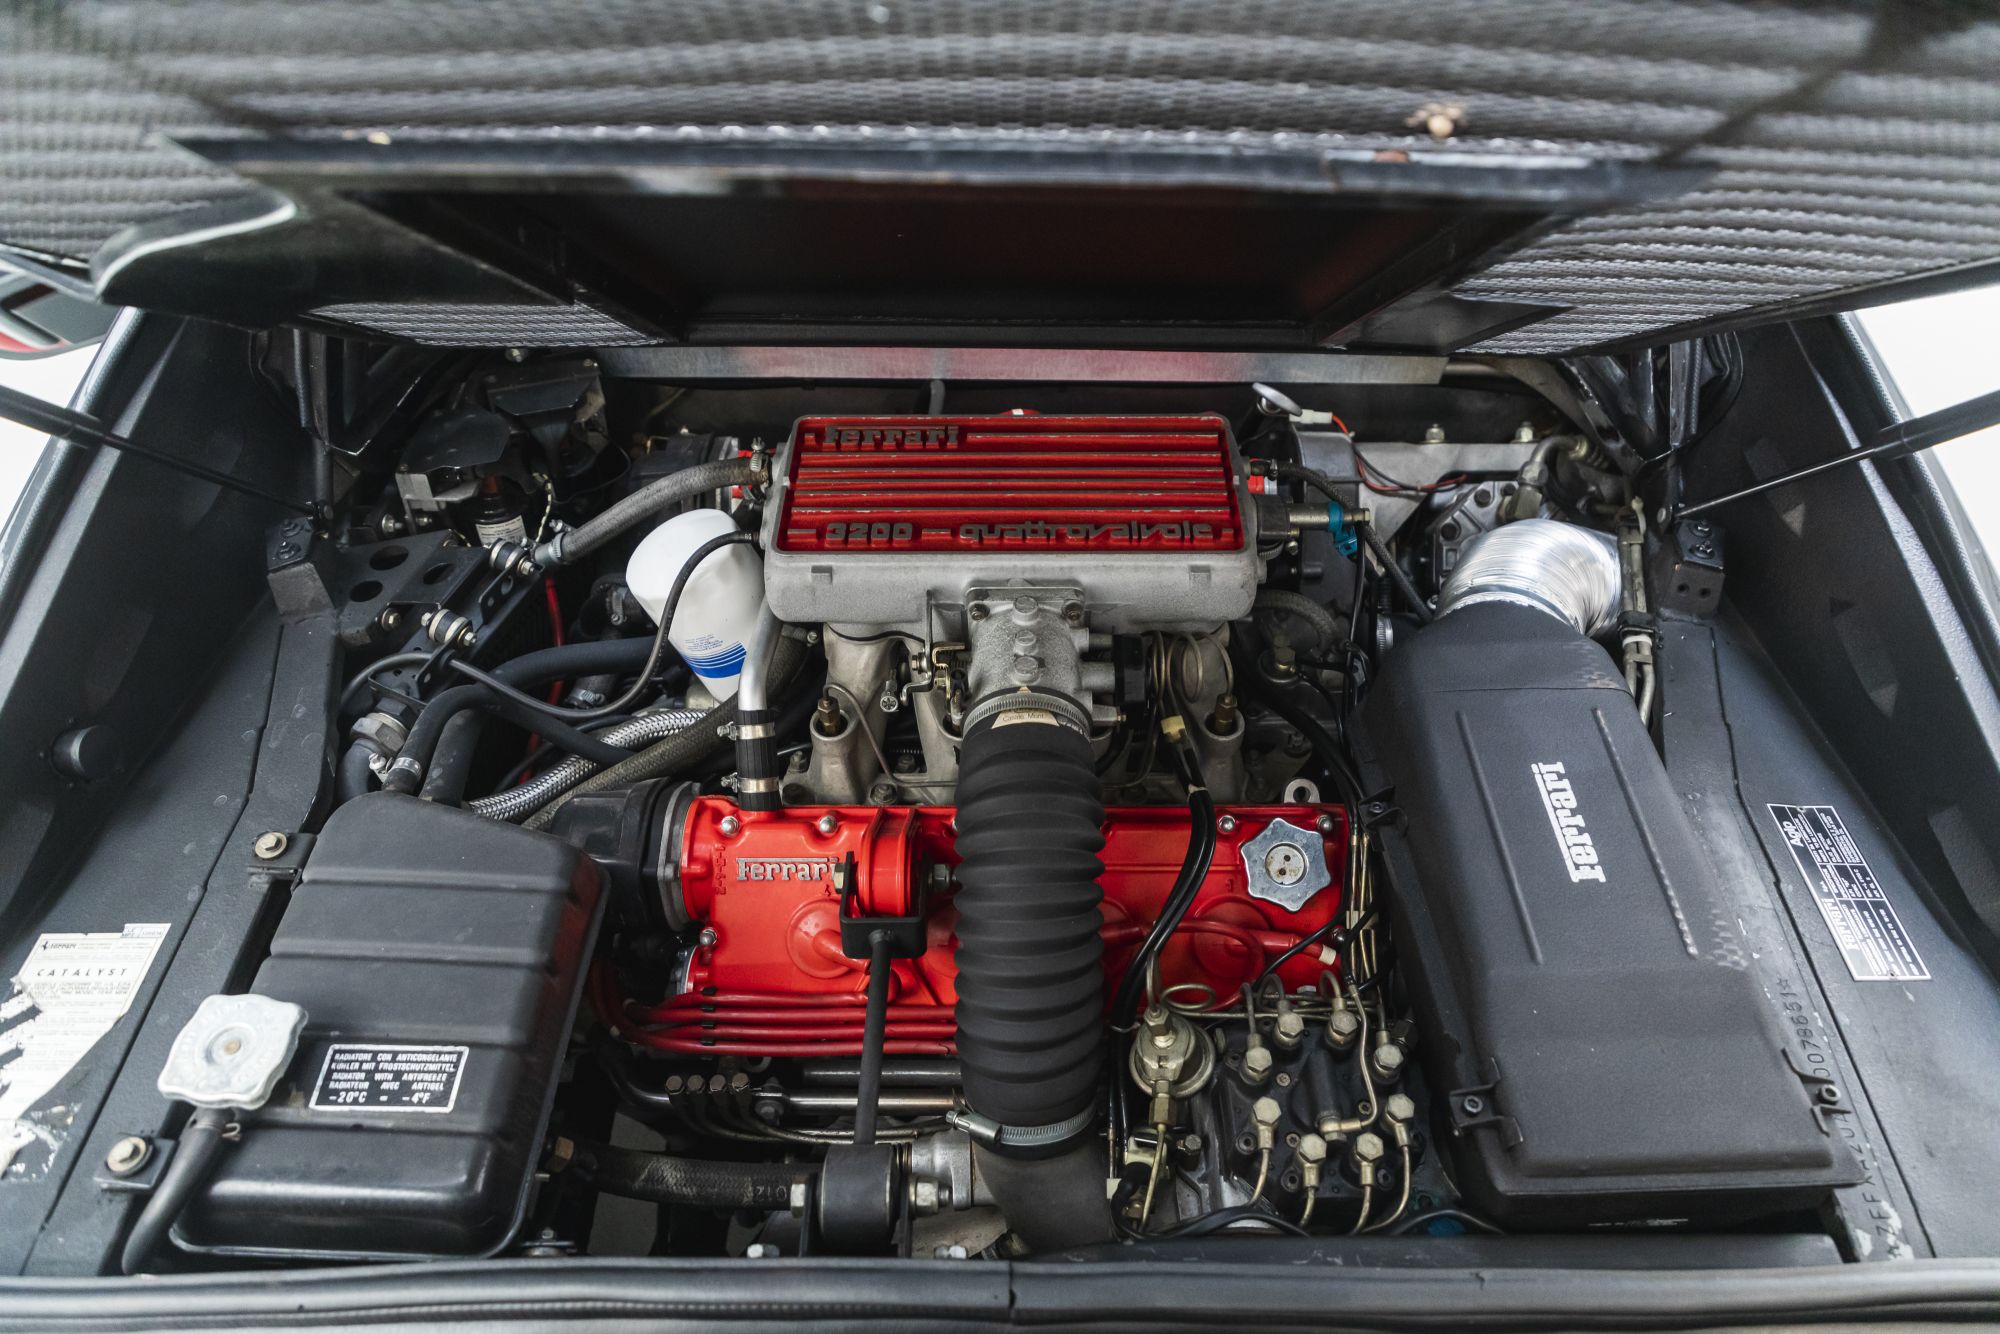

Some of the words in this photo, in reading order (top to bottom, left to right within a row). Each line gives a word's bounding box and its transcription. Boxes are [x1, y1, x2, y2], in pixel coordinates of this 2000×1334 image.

[823, 425, 959, 446] Ferrari
[825, 522, 913, 543] 3200
[958, 520, 1214, 543] quattrovalvole
[1531, 762, 1606, 882] Ferrari
[1783, 821, 1804, 847] Agip
[1824, 899, 1860, 951] Ferrari
[37, 967, 127, 977] CATALYST
[334, 1053, 373, 1062] RADIATORE
[377, 1053, 392, 1062] CON
[396, 1053, 457, 1062] ANTICONGELANTE
[362, 1062, 375, 1071] MIT
[378, 1062, 455, 1072] FROSTSCHUTZMITTEL
[332, 1072, 366, 1080] RADIATOR
[374, 1073, 394, 1081] WITH
[402, 1073, 447, 1081] ANTIFREEZE
[329, 1081, 370, 1089] RADIATEUR
[380, 1082, 400, 1090] AVEC
[411, 1082, 444, 1091] ANTIGEL
